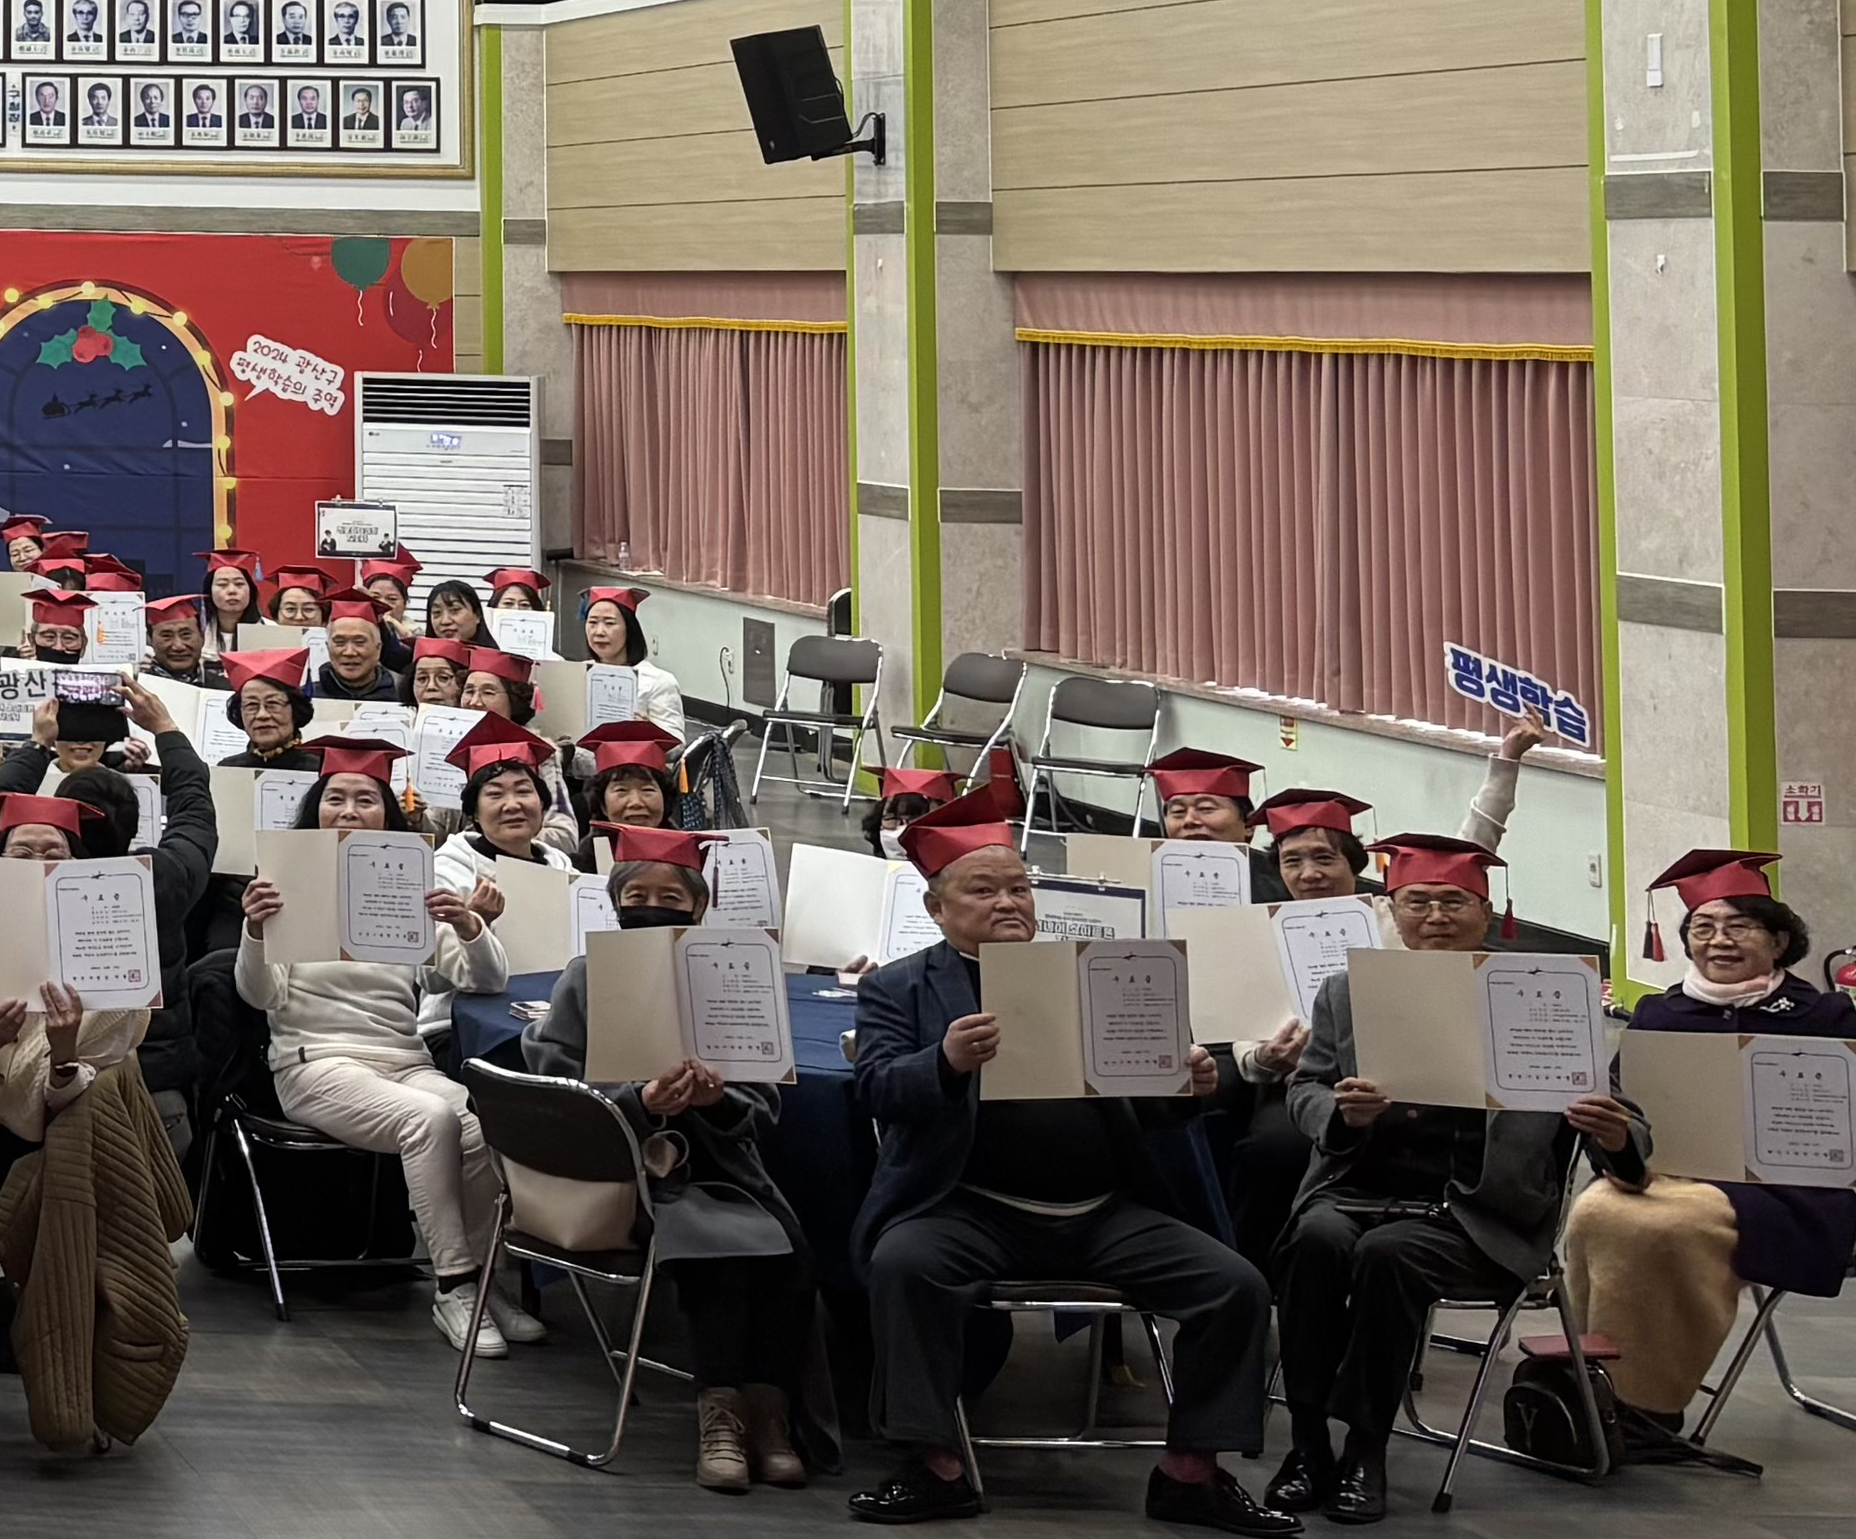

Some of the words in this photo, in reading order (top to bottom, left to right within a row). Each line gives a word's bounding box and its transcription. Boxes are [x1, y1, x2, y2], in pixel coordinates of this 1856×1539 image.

[237, 357, 307, 395] 평생학습의
[312, 388, 338, 409] 주역
[253, 341, 288, 364] 2024
[295, 355, 338, 385] 광산구
[1450, 647, 1586, 743] 평생학습
